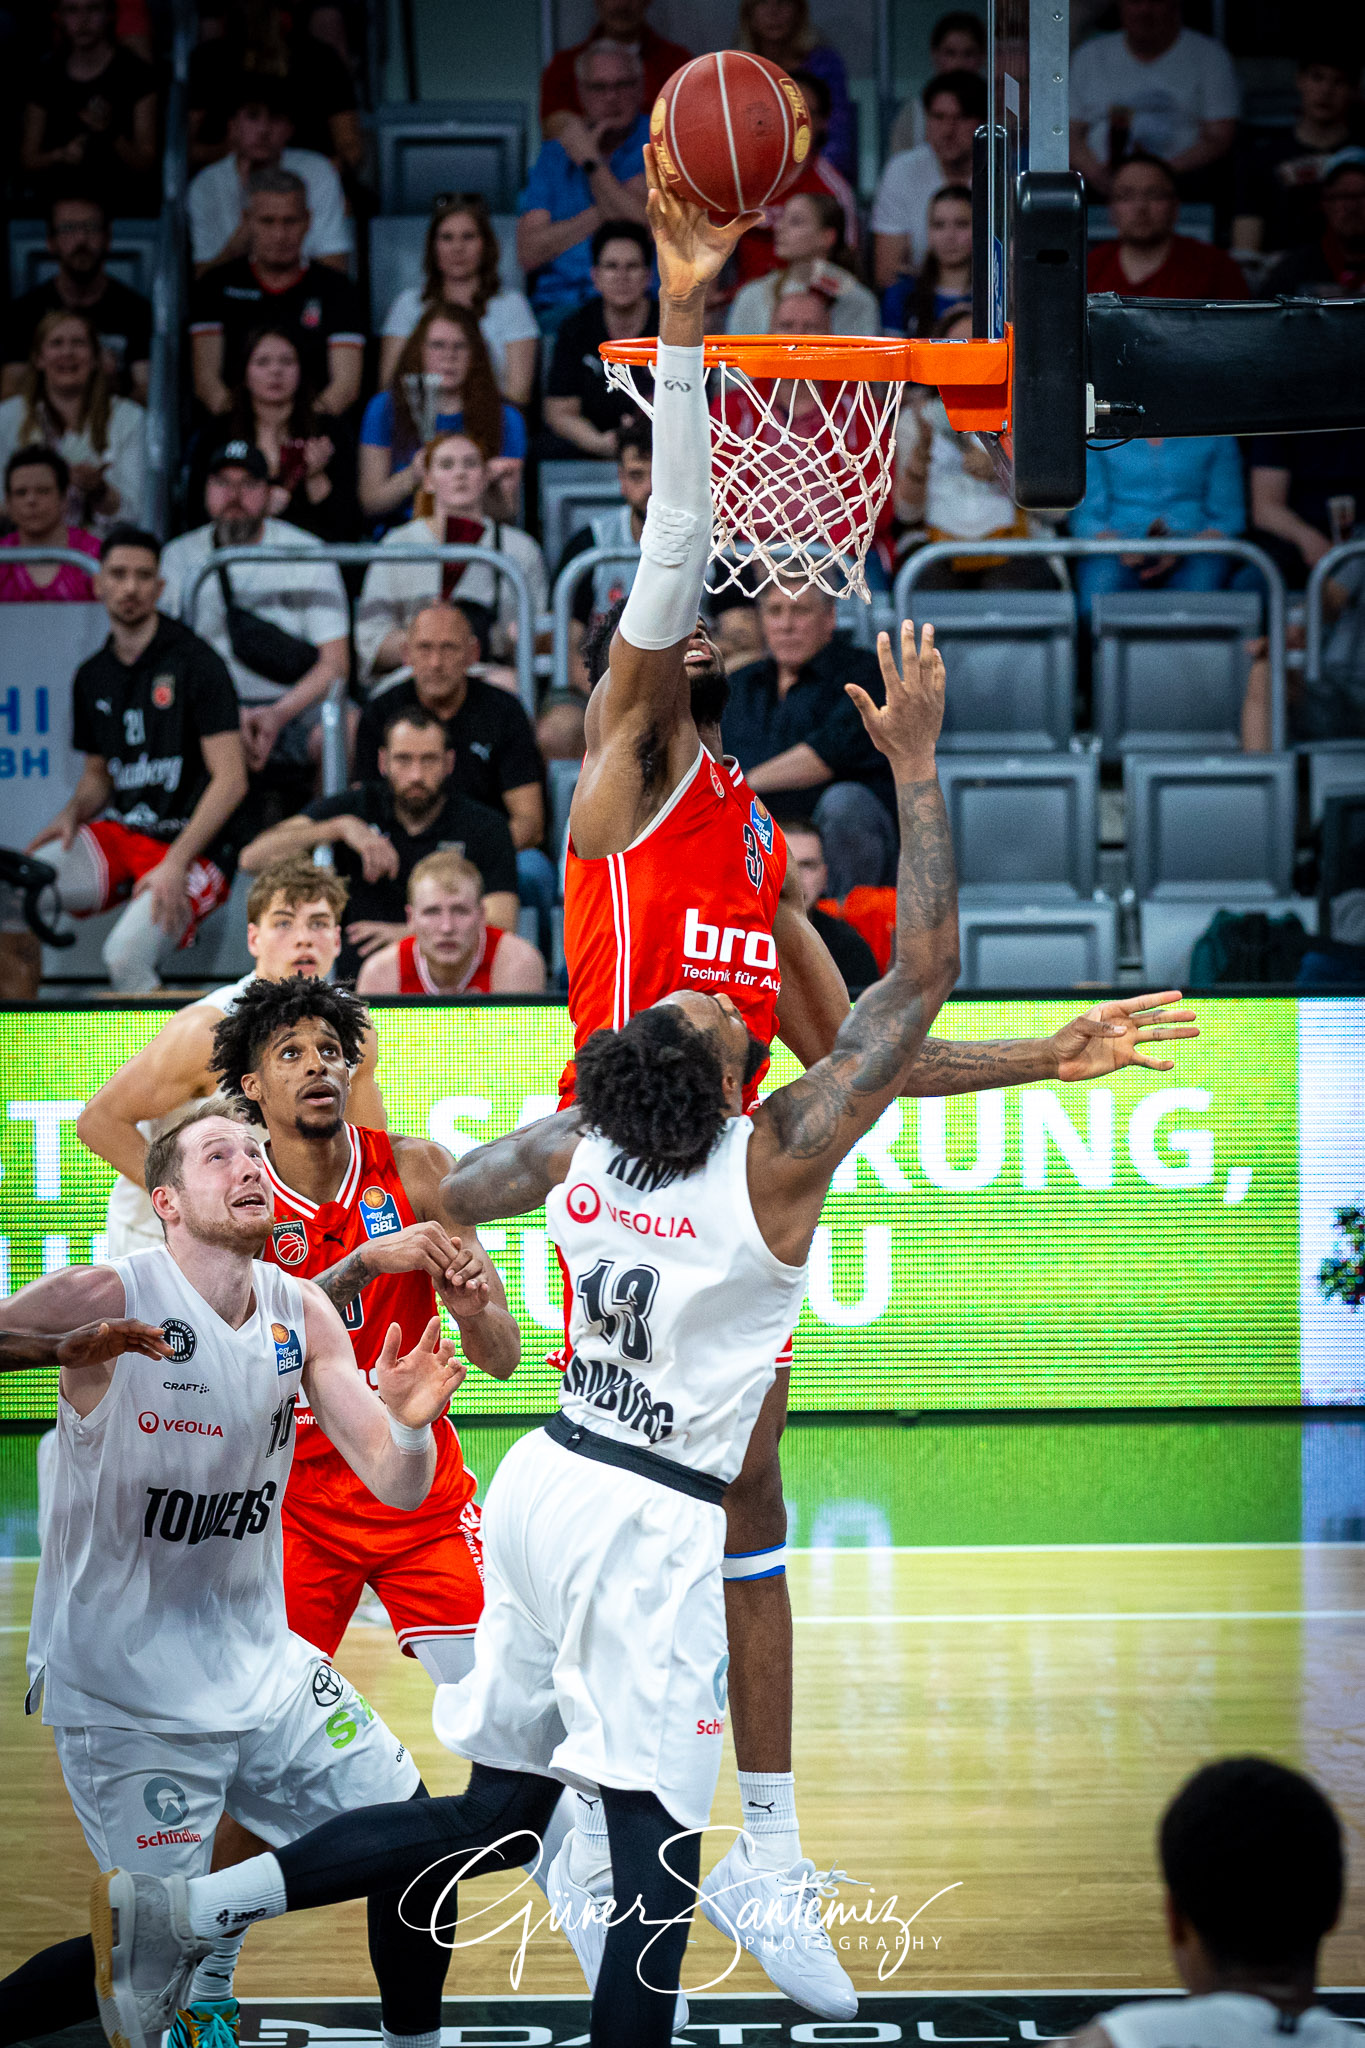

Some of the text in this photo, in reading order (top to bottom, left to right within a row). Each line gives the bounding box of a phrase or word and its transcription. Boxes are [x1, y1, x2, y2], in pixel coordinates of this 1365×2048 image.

[735, 970, 758, 986] für
[370, 1219, 398, 1235] BBL
[606, 1201, 697, 1239] VEOLIA
[576, 1258, 660, 1363] 13
[174, 1321, 195, 1342] TOWERS
[170, 1335, 185, 1353] HH
[278, 1355, 300, 1372] BBL
[163, 1381, 200, 1393] CRAFT
[163, 1418, 224, 1438] VEOLIA
[266, 1392, 298, 1458] 10
[136, 1828, 202, 1849] Schindler
[231, 1907, 267, 1923] CRAFT
